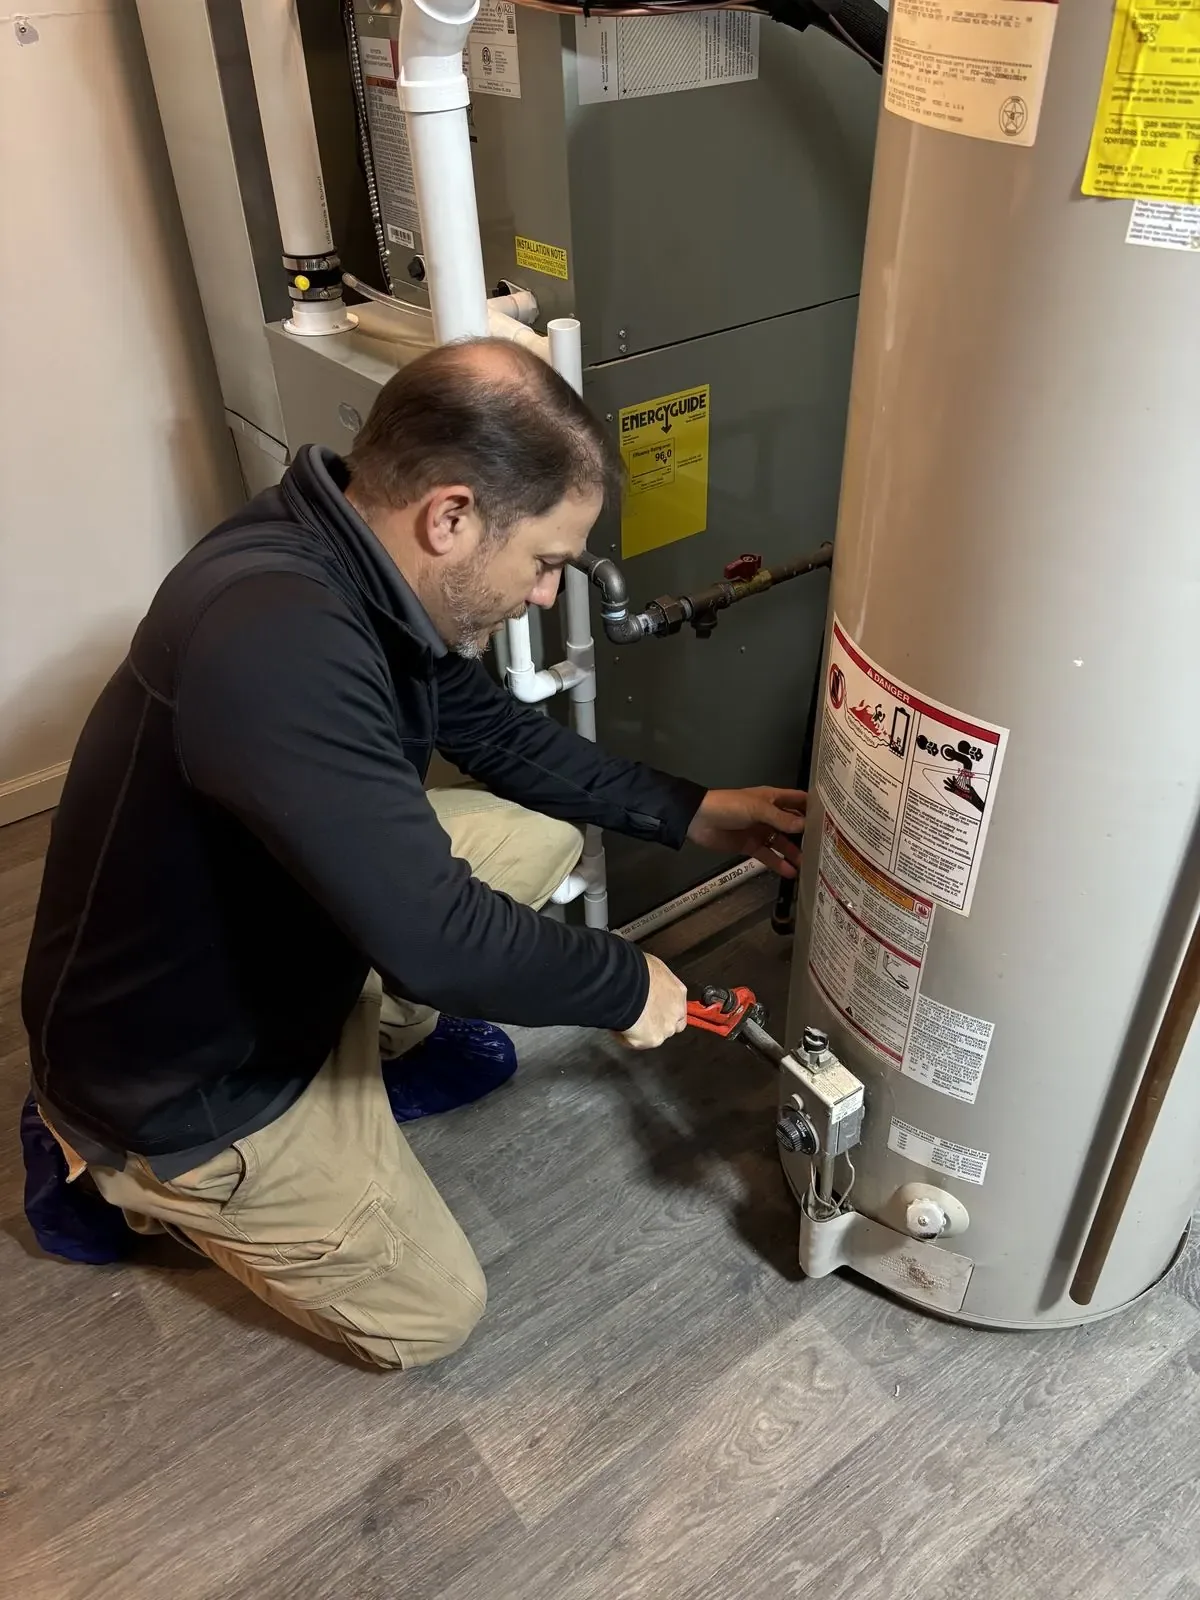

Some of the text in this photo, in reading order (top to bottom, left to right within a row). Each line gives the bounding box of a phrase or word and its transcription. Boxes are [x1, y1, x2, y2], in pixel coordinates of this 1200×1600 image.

[517, 239, 566, 260] INSTALLATION NOTE:
[622, 393, 707, 433] ENERGYGUIDE
[655, 449, 672, 461] 96.0
[873, 673, 910, 703] DANGER
